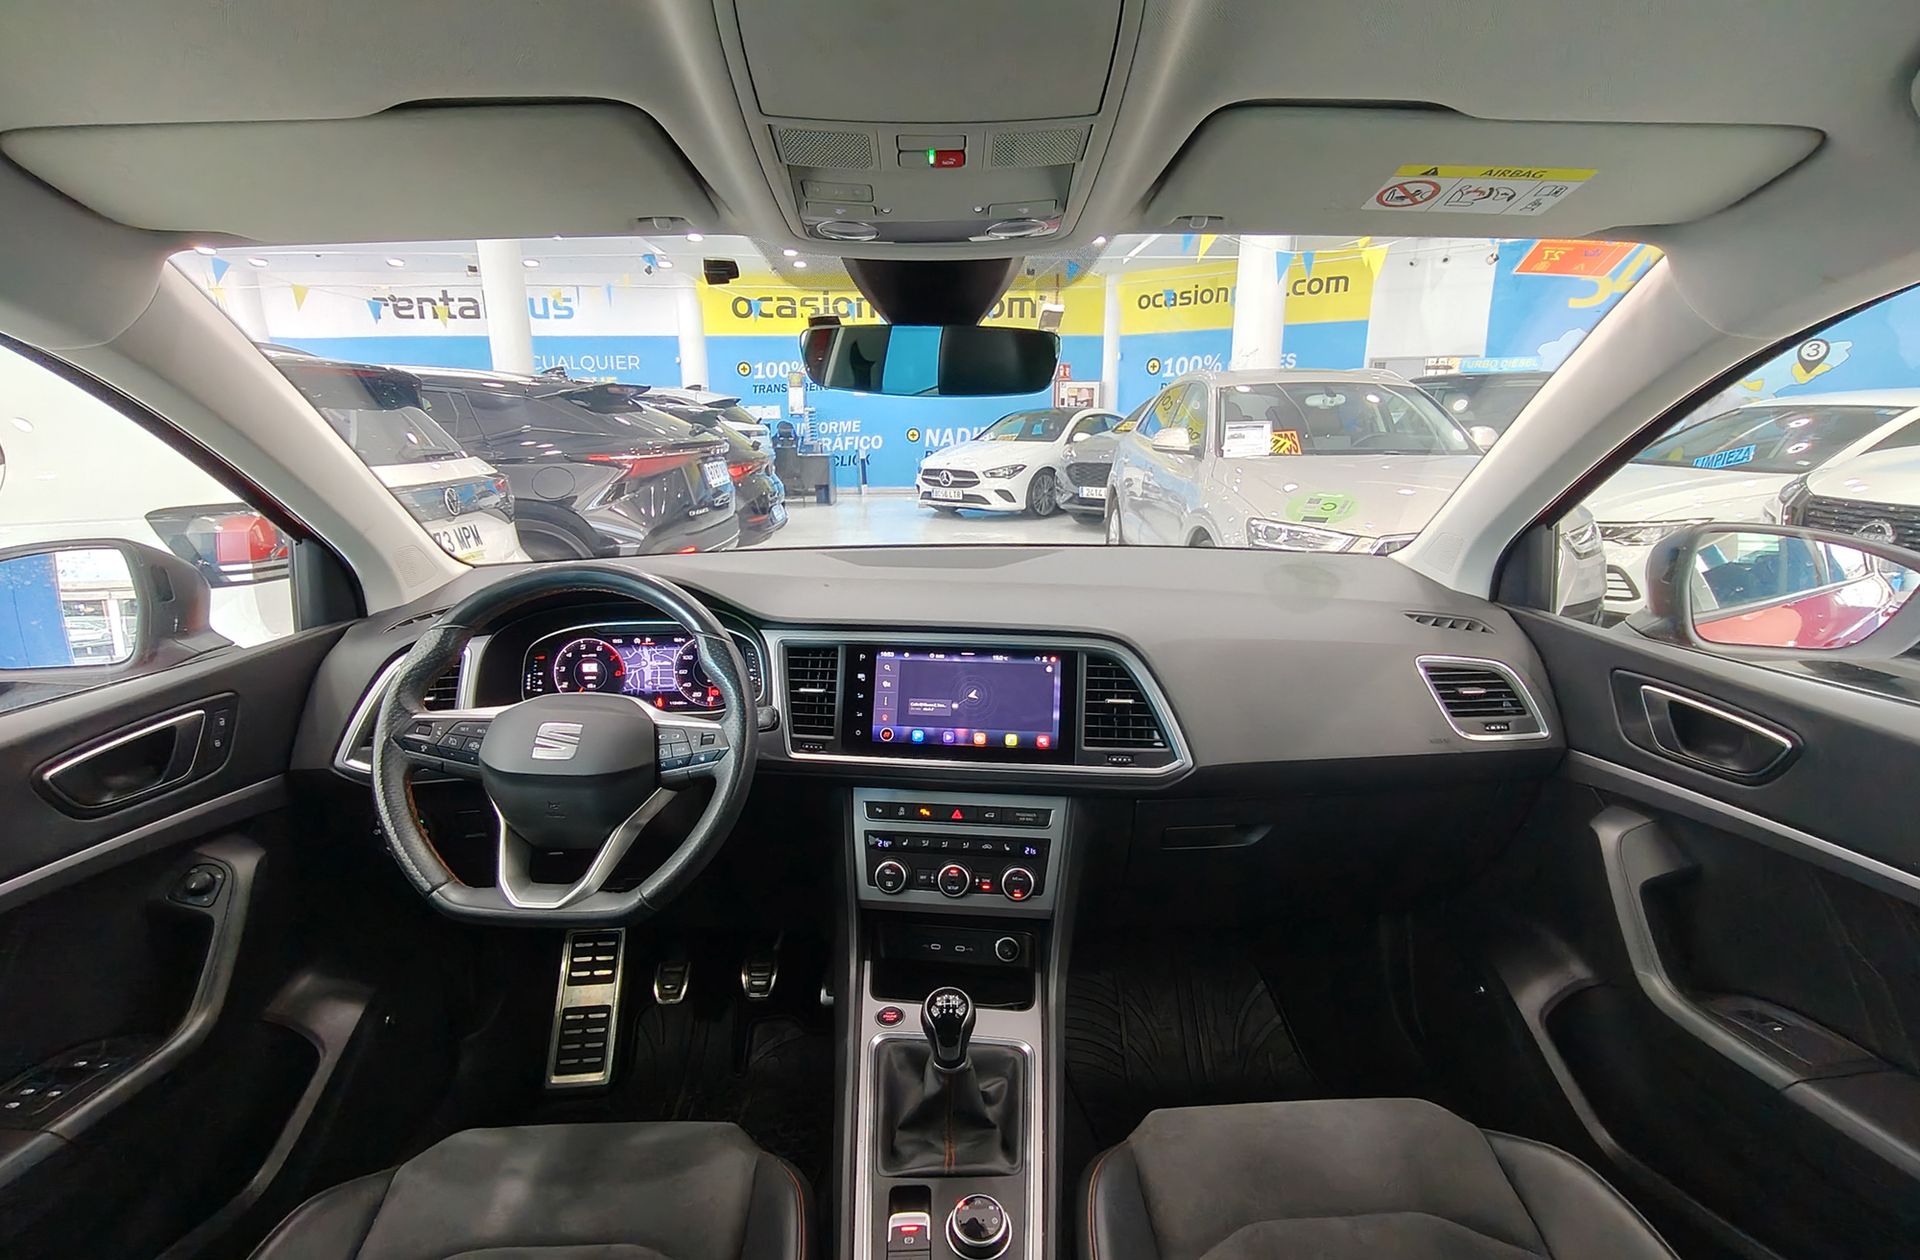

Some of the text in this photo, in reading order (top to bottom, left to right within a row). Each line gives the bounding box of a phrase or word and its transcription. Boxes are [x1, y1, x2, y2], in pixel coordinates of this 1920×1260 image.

[1480, 168, 1547, 179] AIRBAG
[1806, 343, 1820, 358] 3
[1695, 446, 1753, 468] LIMPIEZA
[452, 524, 484, 551] MPM
